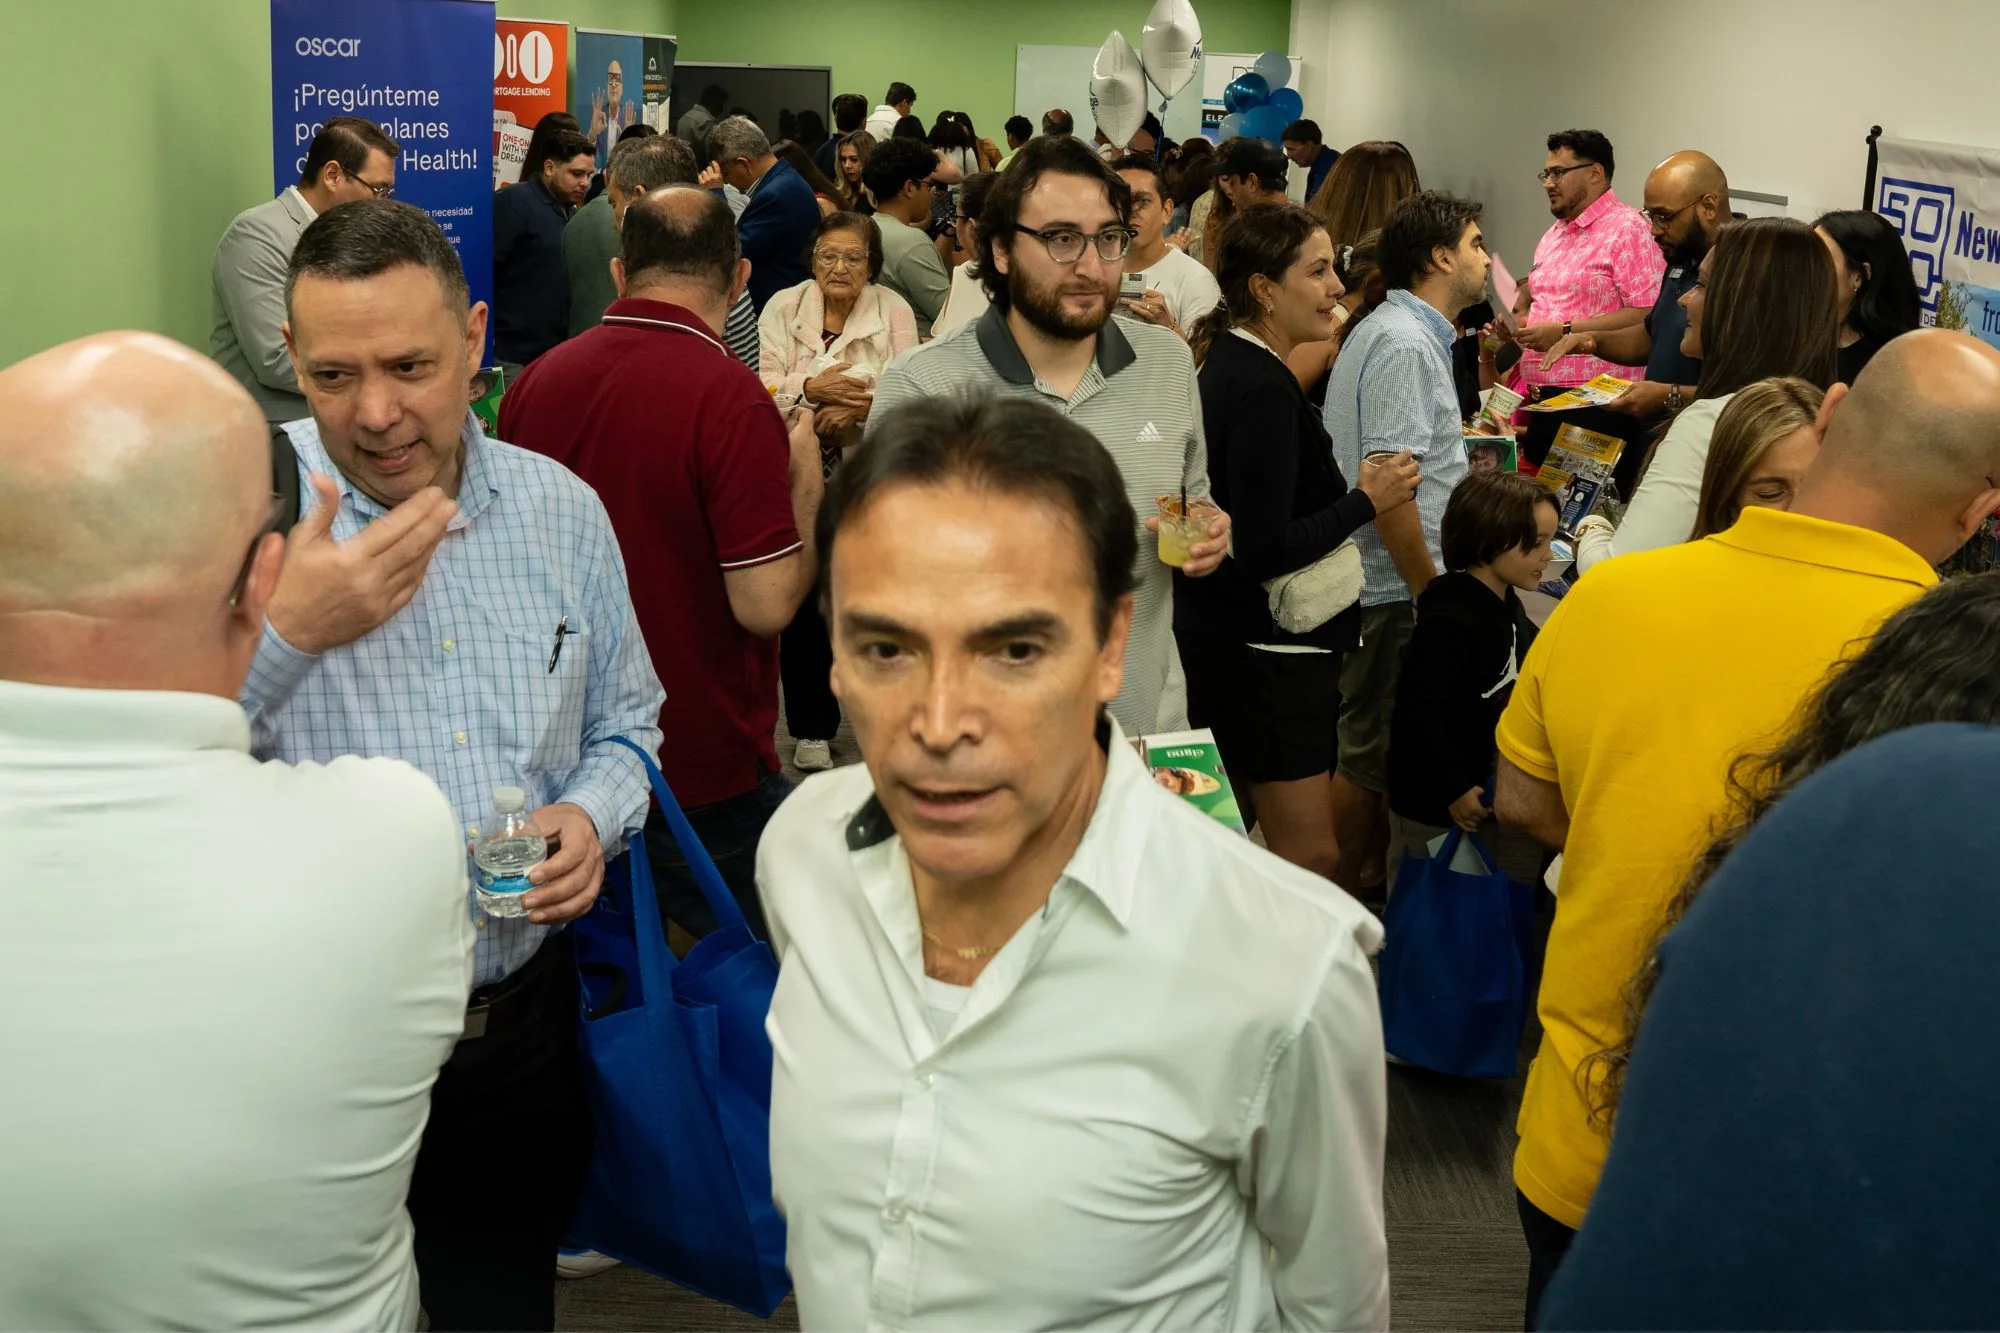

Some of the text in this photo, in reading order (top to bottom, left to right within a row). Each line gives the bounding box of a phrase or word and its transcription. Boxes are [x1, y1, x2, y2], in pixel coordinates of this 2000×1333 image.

[295, 37, 361, 57] oscar
[294, 83, 440, 112] ¡Pregúnteme
[521, 87, 551, 96] LENDING
[1205, 113, 1224, 122] ELE
[380, 117, 449, 139] planes
[502, 133, 529, 147] ONE-ON
[502, 142, 519, 155] WITH
[403, 149, 477, 171] Health!
[501, 151, 524, 163] DREAM
[432, 206, 473, 217] necesidad
